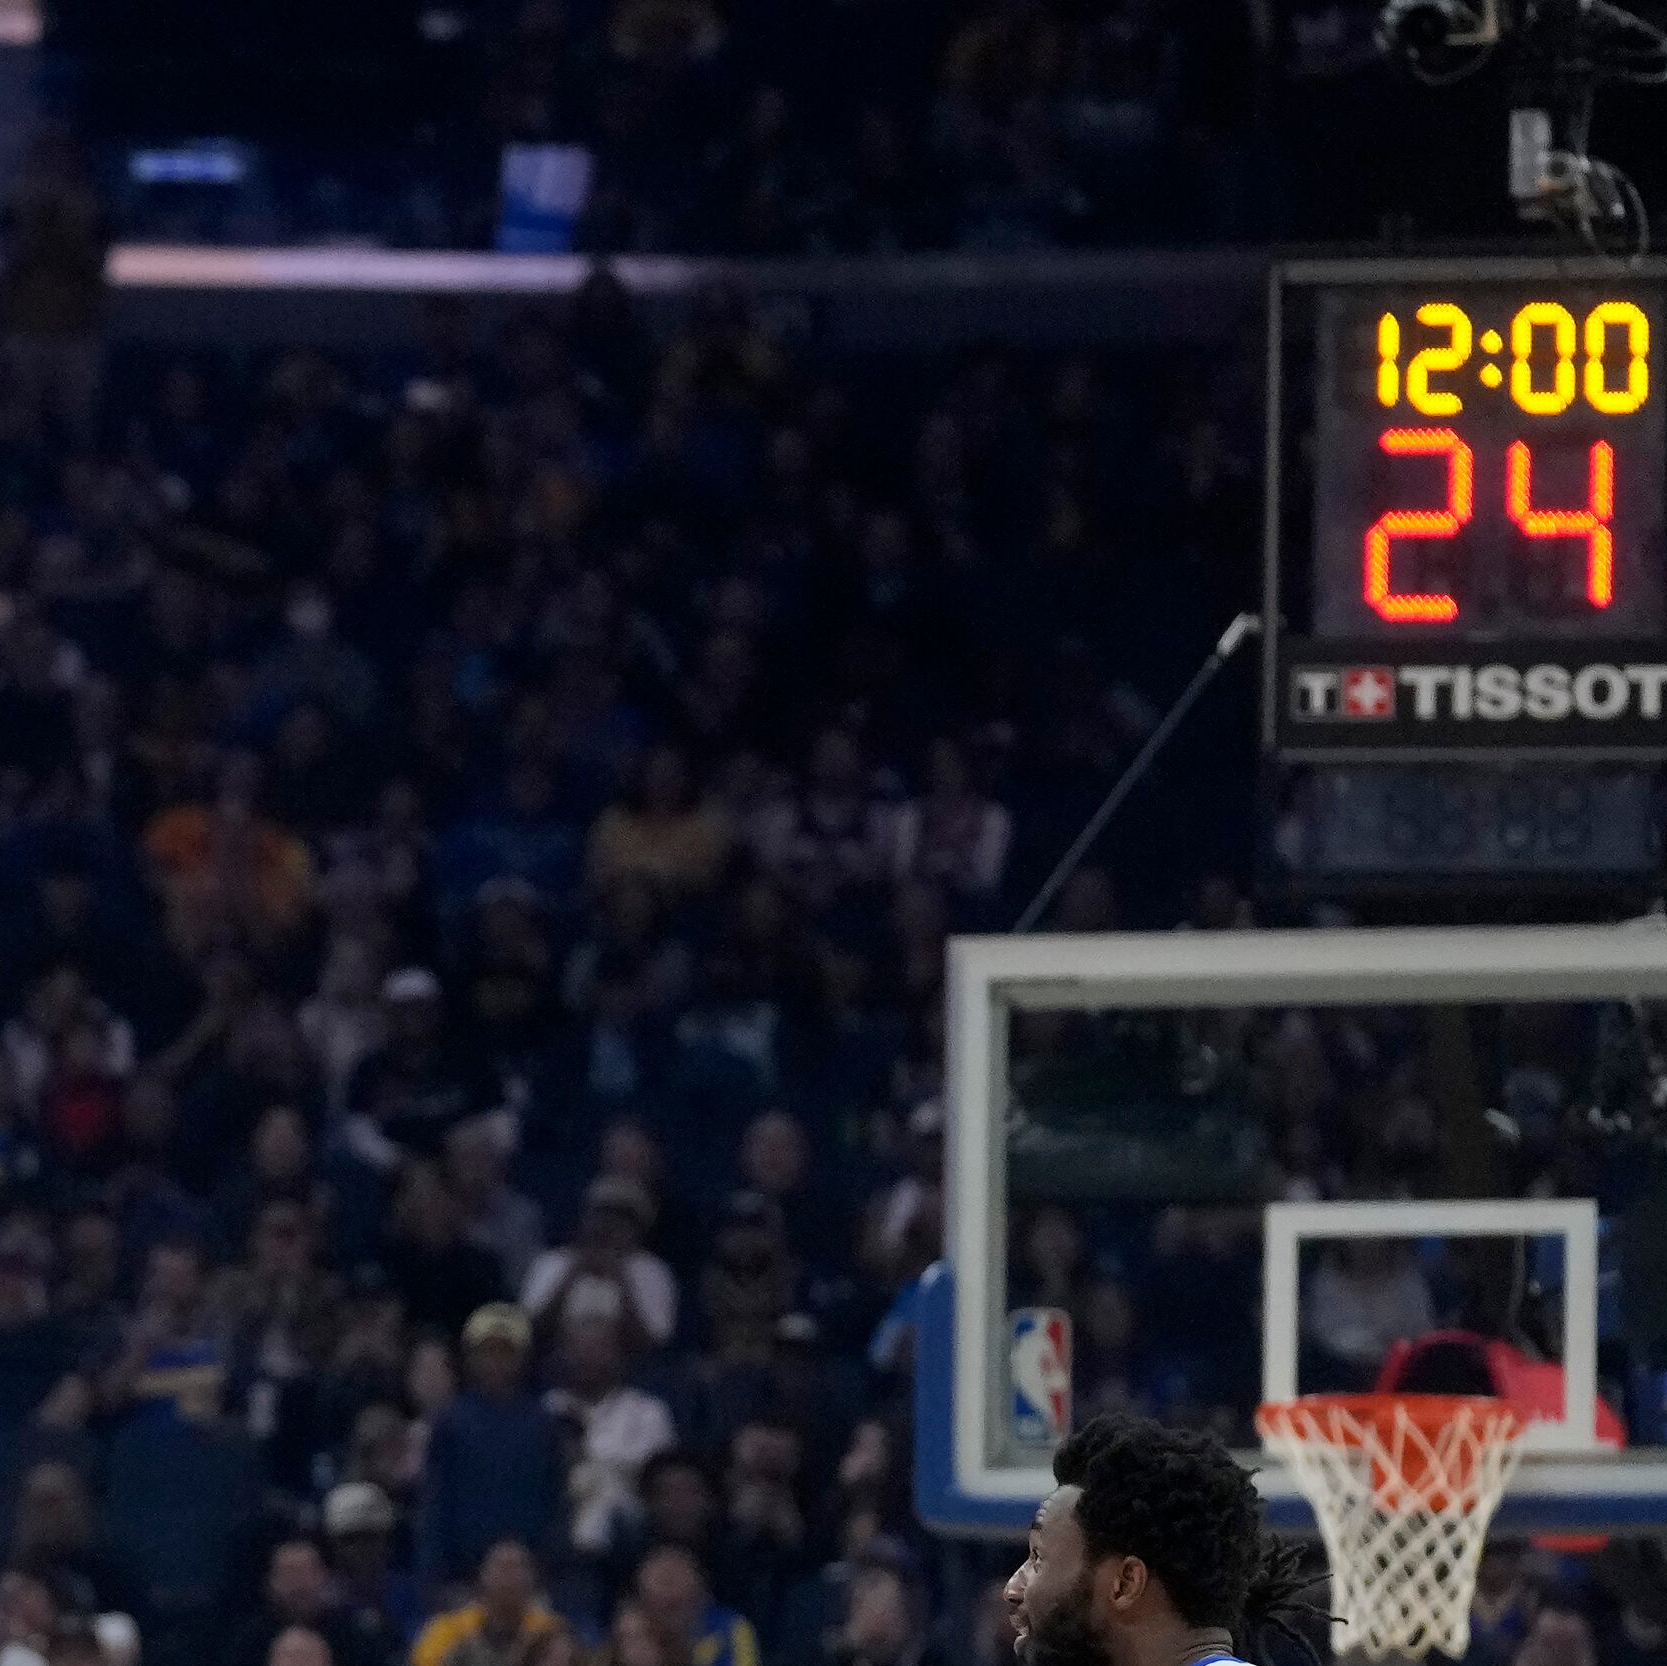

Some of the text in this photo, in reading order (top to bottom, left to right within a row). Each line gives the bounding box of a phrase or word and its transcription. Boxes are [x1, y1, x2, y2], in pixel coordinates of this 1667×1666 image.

[1376, 302, 1650, 415] 12:00
[1364, 427, 1615, 622] 24
[1400, 664, 1667, 721] TISSOT
